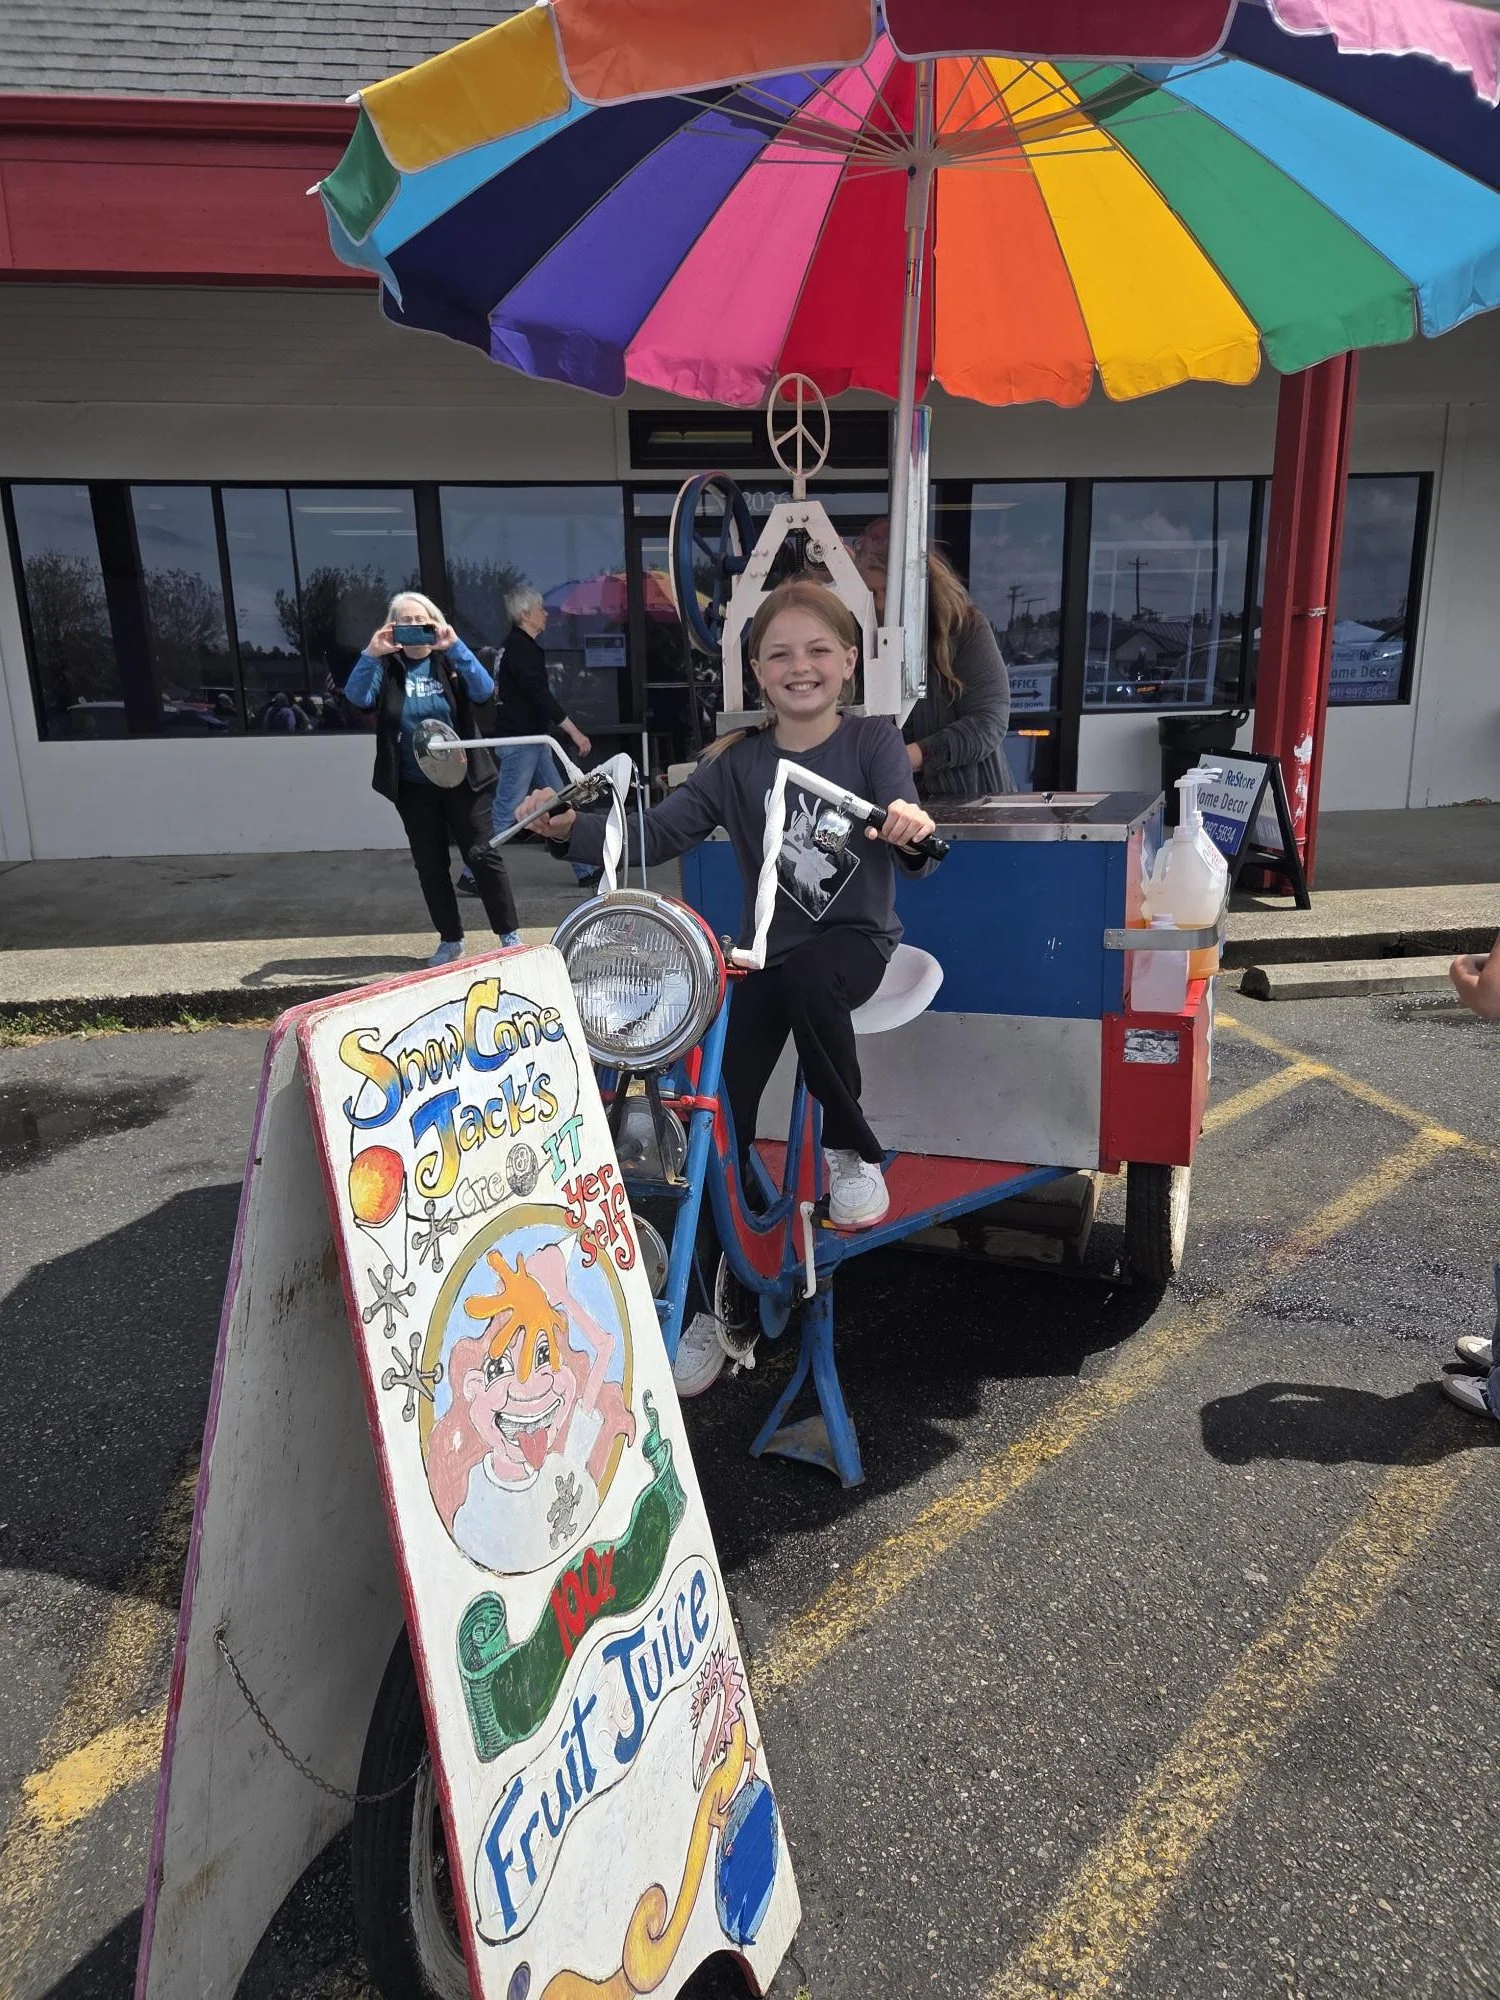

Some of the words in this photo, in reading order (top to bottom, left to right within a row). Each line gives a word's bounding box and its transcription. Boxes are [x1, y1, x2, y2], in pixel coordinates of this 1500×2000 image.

[1331, 667, 1357, 678] ome
[1361, 665, 1396, 678] Decor
[1220, 793, 1249, 815] Decor
[1225, 769, 1256, 790] ReStore
[410, 1062, 558, 1198] Jack's
[542, 1114, 583, 1184] IT
[561, 1163, 614, 1227] yer
[580, 1183, 635, 1271] self
[550, 1545, 616, 1661] 100%
[485, 1694, 598, 1934] Fruit
[603, 1569, 710, 1766] Juice
